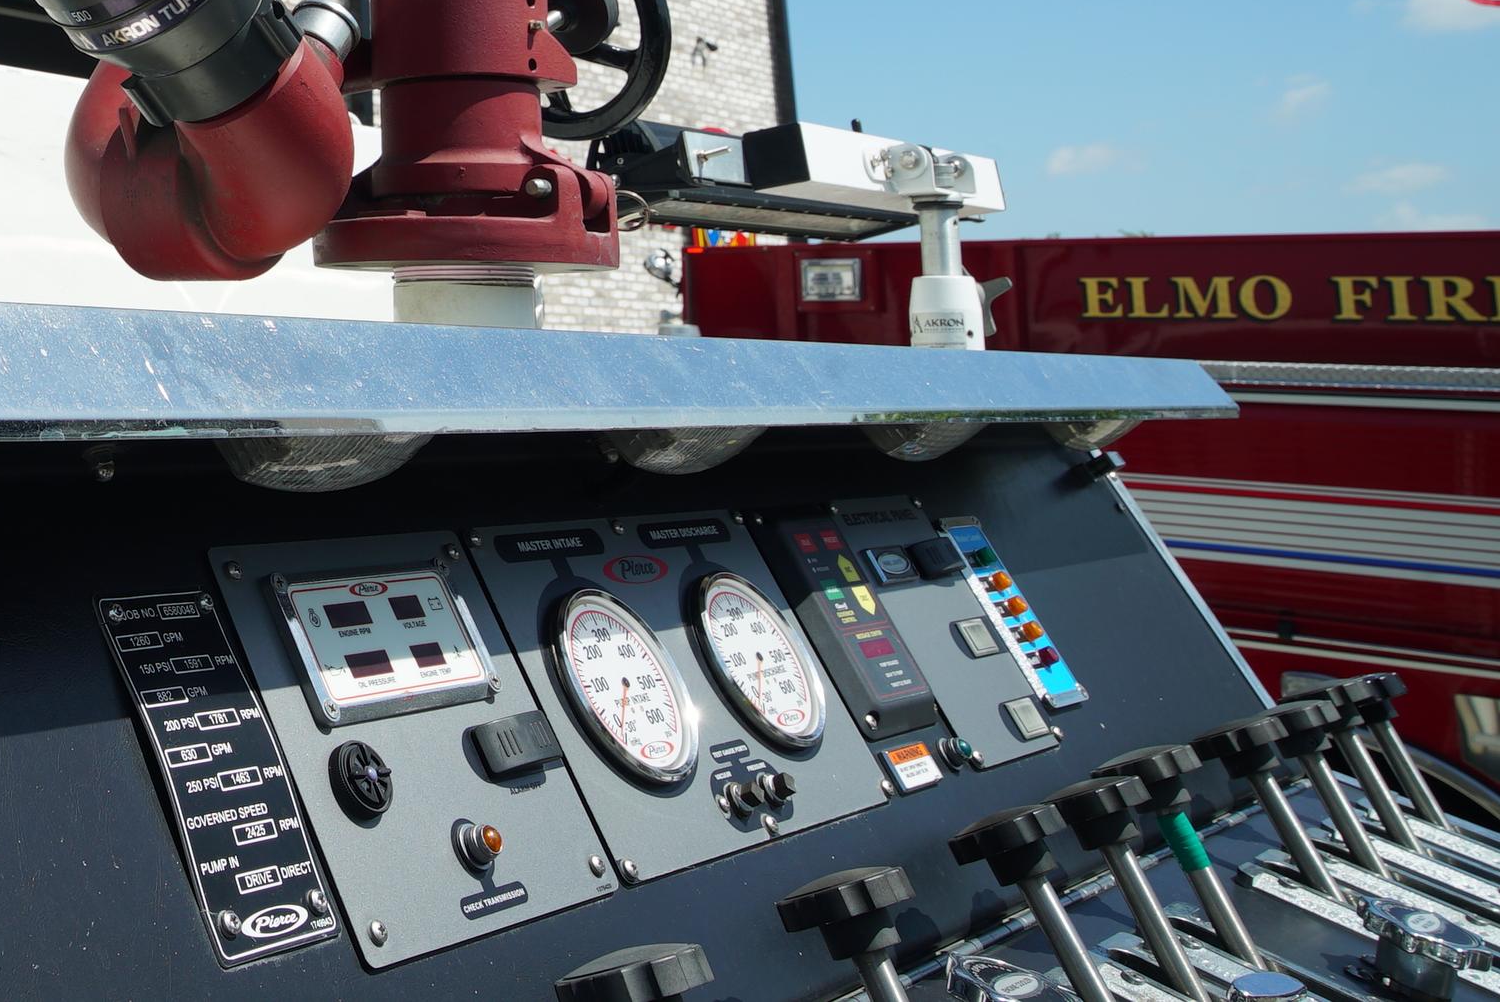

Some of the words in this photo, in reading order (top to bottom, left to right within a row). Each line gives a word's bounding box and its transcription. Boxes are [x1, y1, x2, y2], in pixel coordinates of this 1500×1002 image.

[71, 10, 92, 23] 500
[101, 14, 161, 47] AKRON
[1078, 275, 1293, 321] ELMO
[924, 318, 965, 327] AKRON
[649, 527, 679, 540] MASTER
[679, 525, 719, 538] DISCHARGE
[516, 539, 552, 552] MASTER
[552, 536, 583, 549] INTAKE
[618, 558, 656, 579] Pierce
[140, 607, 159, 618] NO.
[726, 607, 744, 621] 300
[338, 628, 360, 638] ENGINE
[360, 627, 372, 636] RPM
[403, 620, 427, 630] VOLTAGE
[721, 622, 738, 637] 200
[749, 621, 766, 636] 400
[130, 635, 151, 647] 1260
[163, 632, 184, 643] GPM
[591, 628, 611, 643] 300
[583, 644, 603, 660] 200
[618, 644, 636, 659] 400
[729, 652, 747, 667] 100
[769, 648, 786, 664] 500
[140, 663, 156, 675] 150
[156, 661, 171, 673] PSI
[184, 658, 203, 670] 1591
[214, 654, 235, 666] RPM
[358, 679, 368, 688] OIL
[368, 676, 397, 687] PRESSURE
[420, 669, 436, 679] ENGINE
[636, 674, 656, 690] 500
[591, 676, 610, 693] 100
[751, 685, 760, 698] 0
[778, 679, 796, 695] 600
[156, 690, 174, 702] 882
[187, 686, 208, 698] GPM
[631, 693, 651, 704] INTAKE
[164, 720, 180, 732] 200
[180, 717, 197, 729] PSI
[208, 713, 229, 725] 1781
[240, 707, 261, 720] RPM
[613, 713, 622, 728] 0
[645, 708, 665, 725] 600
[181, 748, 197, 761] 630
[211, 742, 233, 755] GPM
[186, 781, 202, 793] 250
[203, 777, 219, 790] PSI
[230, 772, 251, 785] 1463
[262, 765, 283, 779] RPM
[186, 809, 237, 830] GOVERNED
[238, 802, 268, 820] SPEED
[245, 826, 266, 839] 2425
[278, 816, 300, 832] RPM
[200, 858, 228, 876] PUMP
[228, 855, 240, 869] IN
[244, 870, 274, 888] DRIVE
[281, 860, 312, 879] DIRECT
[463, 900, 484, 913] CHECK
[483, 888, 525, 907] TRANSMISSION
[254, 911, 298, 934] Pierce
